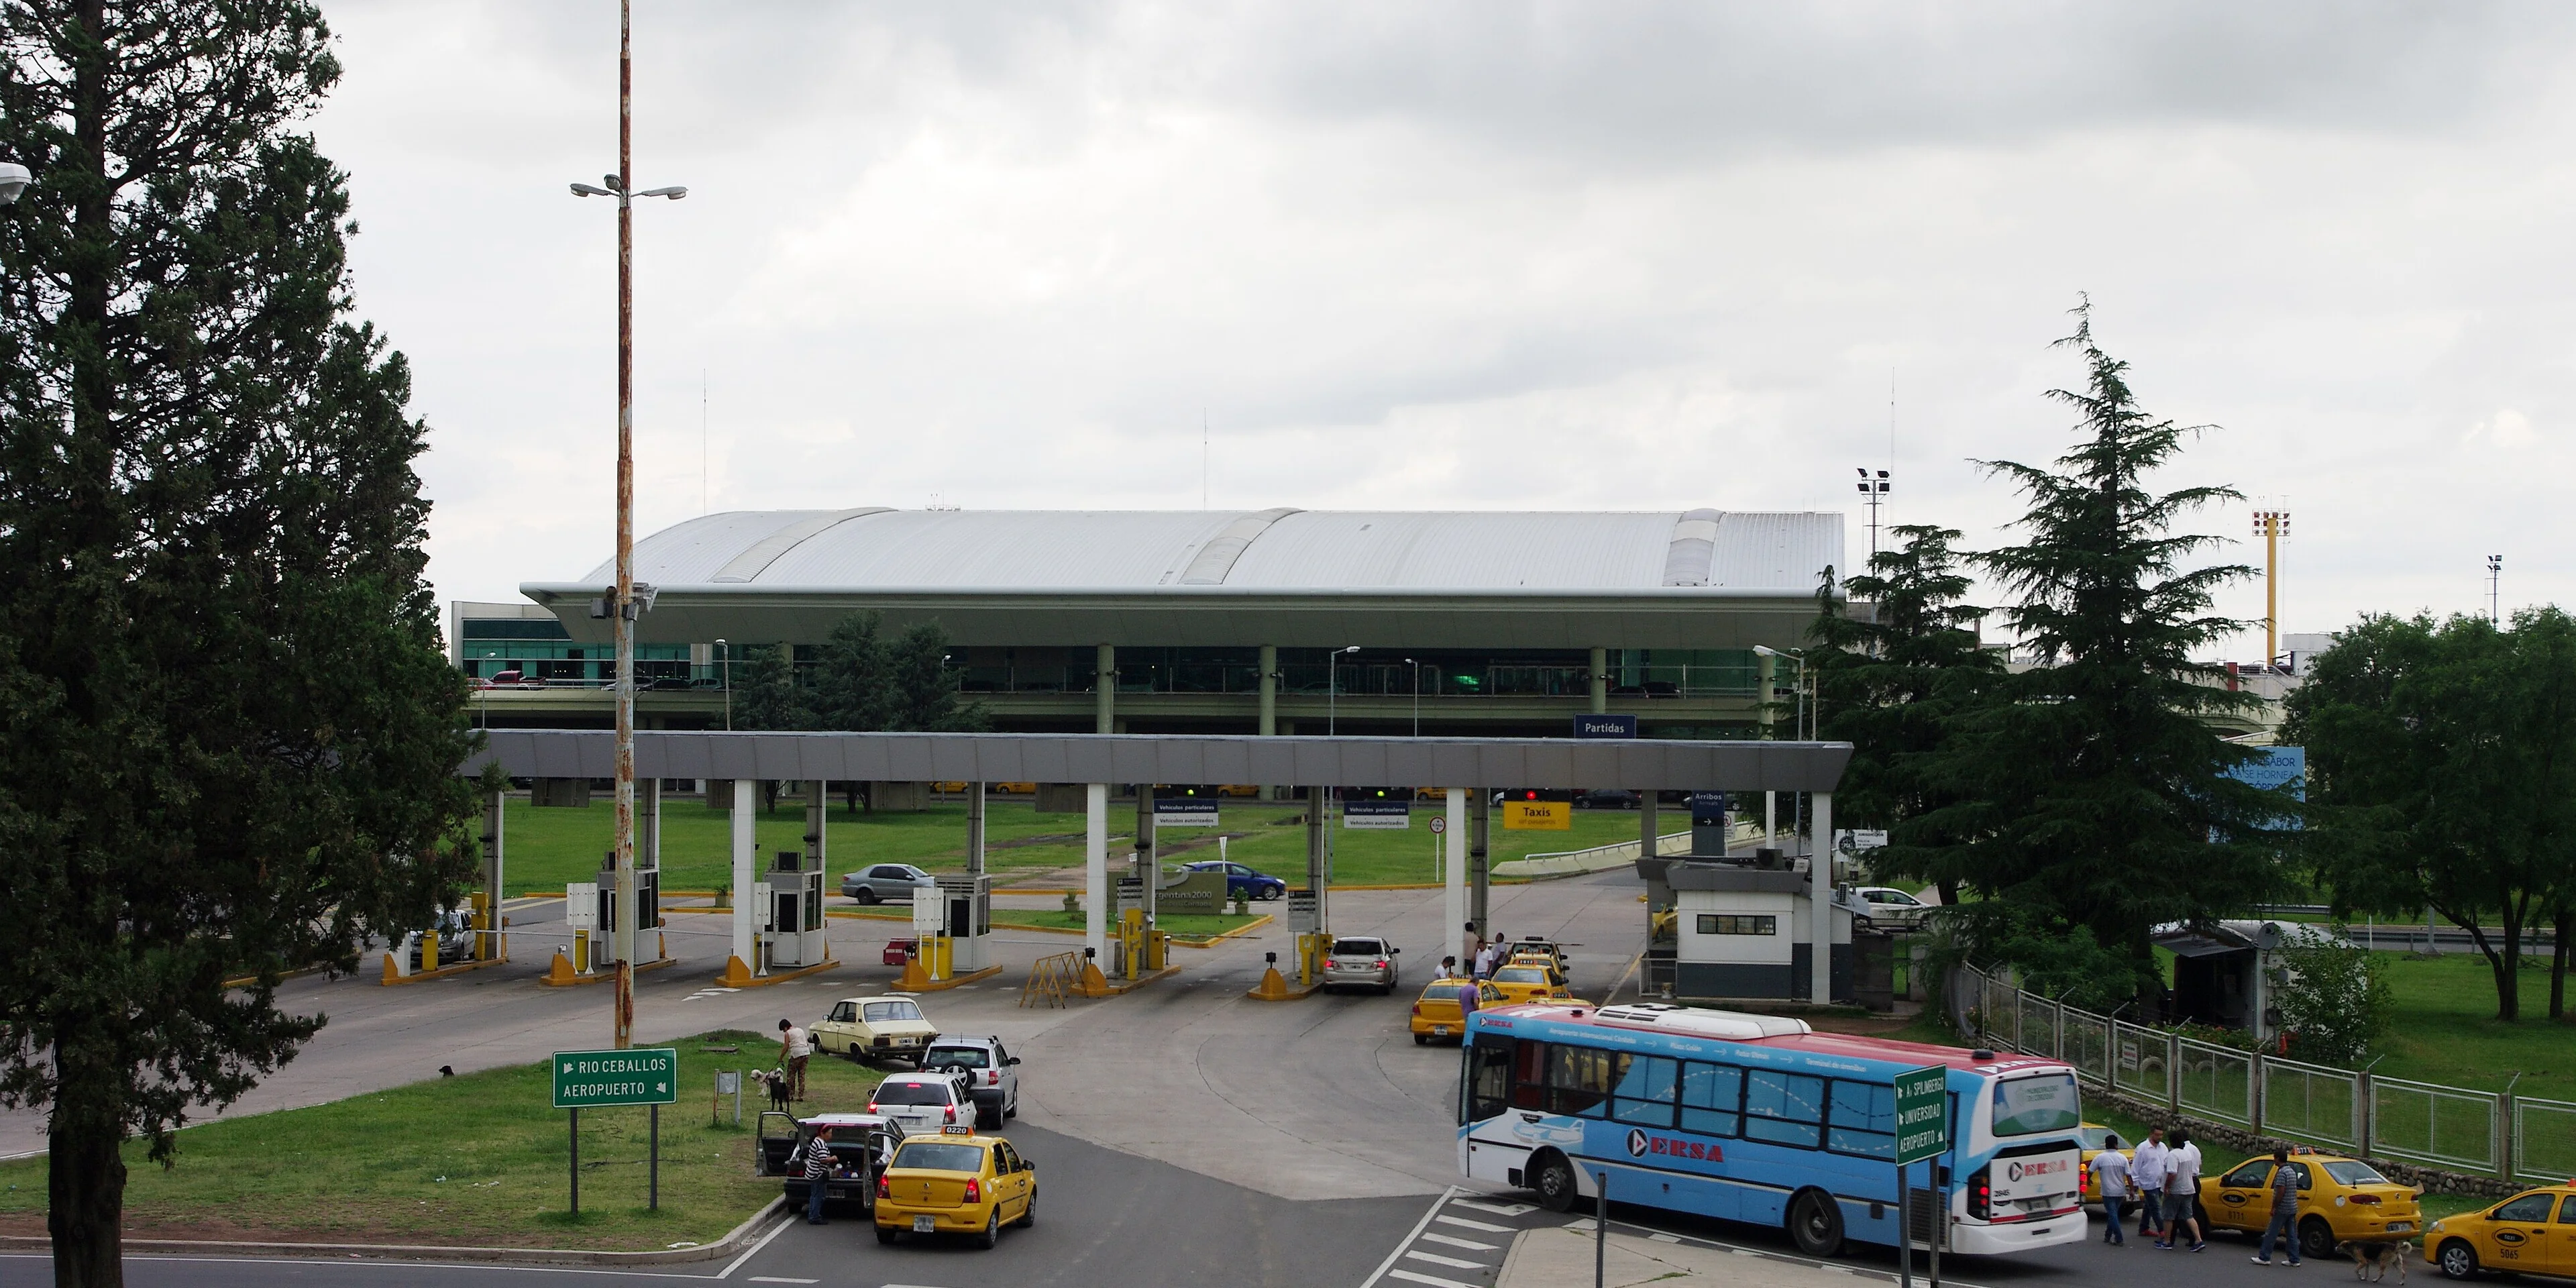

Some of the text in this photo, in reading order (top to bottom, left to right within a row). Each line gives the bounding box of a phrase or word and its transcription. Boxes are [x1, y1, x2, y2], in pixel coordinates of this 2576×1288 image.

[1585, 722, 1625, 733] Partidas
[1523, 807, 1551, 816] Taxis
[579, 1059, 666, 1073] RIO CEBALLOS
[564, 1082, 645, 1097] AEROPUERTO
[1905, 1104, 1941, 1124] UNIVERSIDAD
[947, 1126, 967, 1134] 0220
[1900, 1130, 1935, 1153] AEROPUERTO
[1650, 1136, 1724, 1163] ERSA
[2025, 1160, 2068, 1176] ERSA
[2501, 1248, 2518, 1259] 5065
